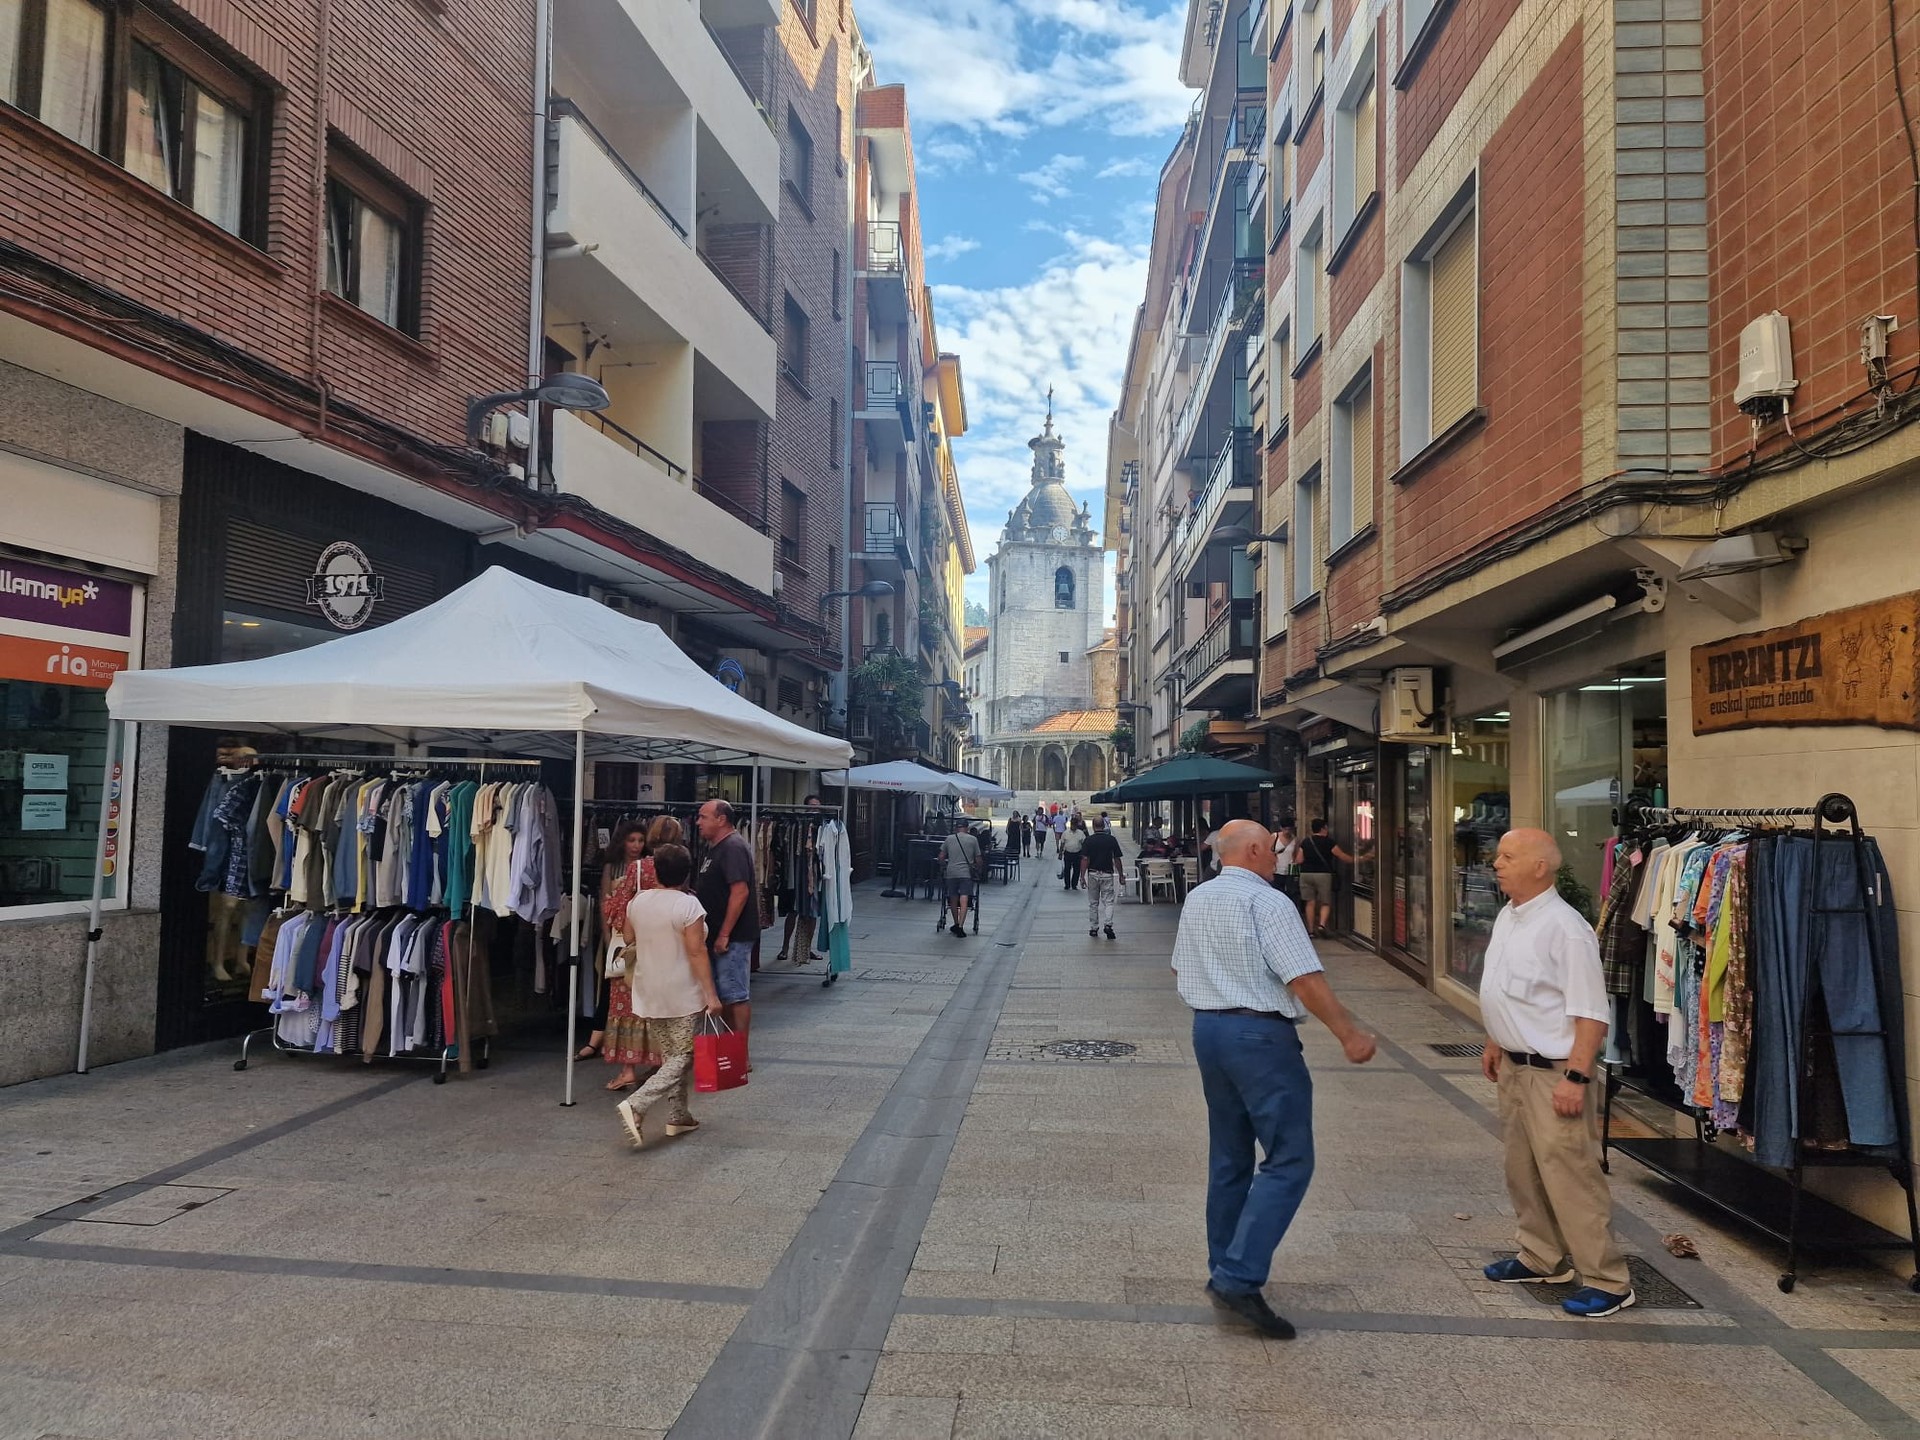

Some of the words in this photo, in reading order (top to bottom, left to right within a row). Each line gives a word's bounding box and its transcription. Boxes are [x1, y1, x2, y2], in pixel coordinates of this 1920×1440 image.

[324, 574, 370, 597] 1971
[46, 645, 88, 677] ria
[91, 658, 120, 671] Money
[1708, 632, 1823, 694] IRRINTZI
[91, 670, 113, 680] Trans
[1709, 690, 1743, 716] euskal
[1745, 686, 1775, 718] jantzi
[1778, 682, 1814, 707] denda
